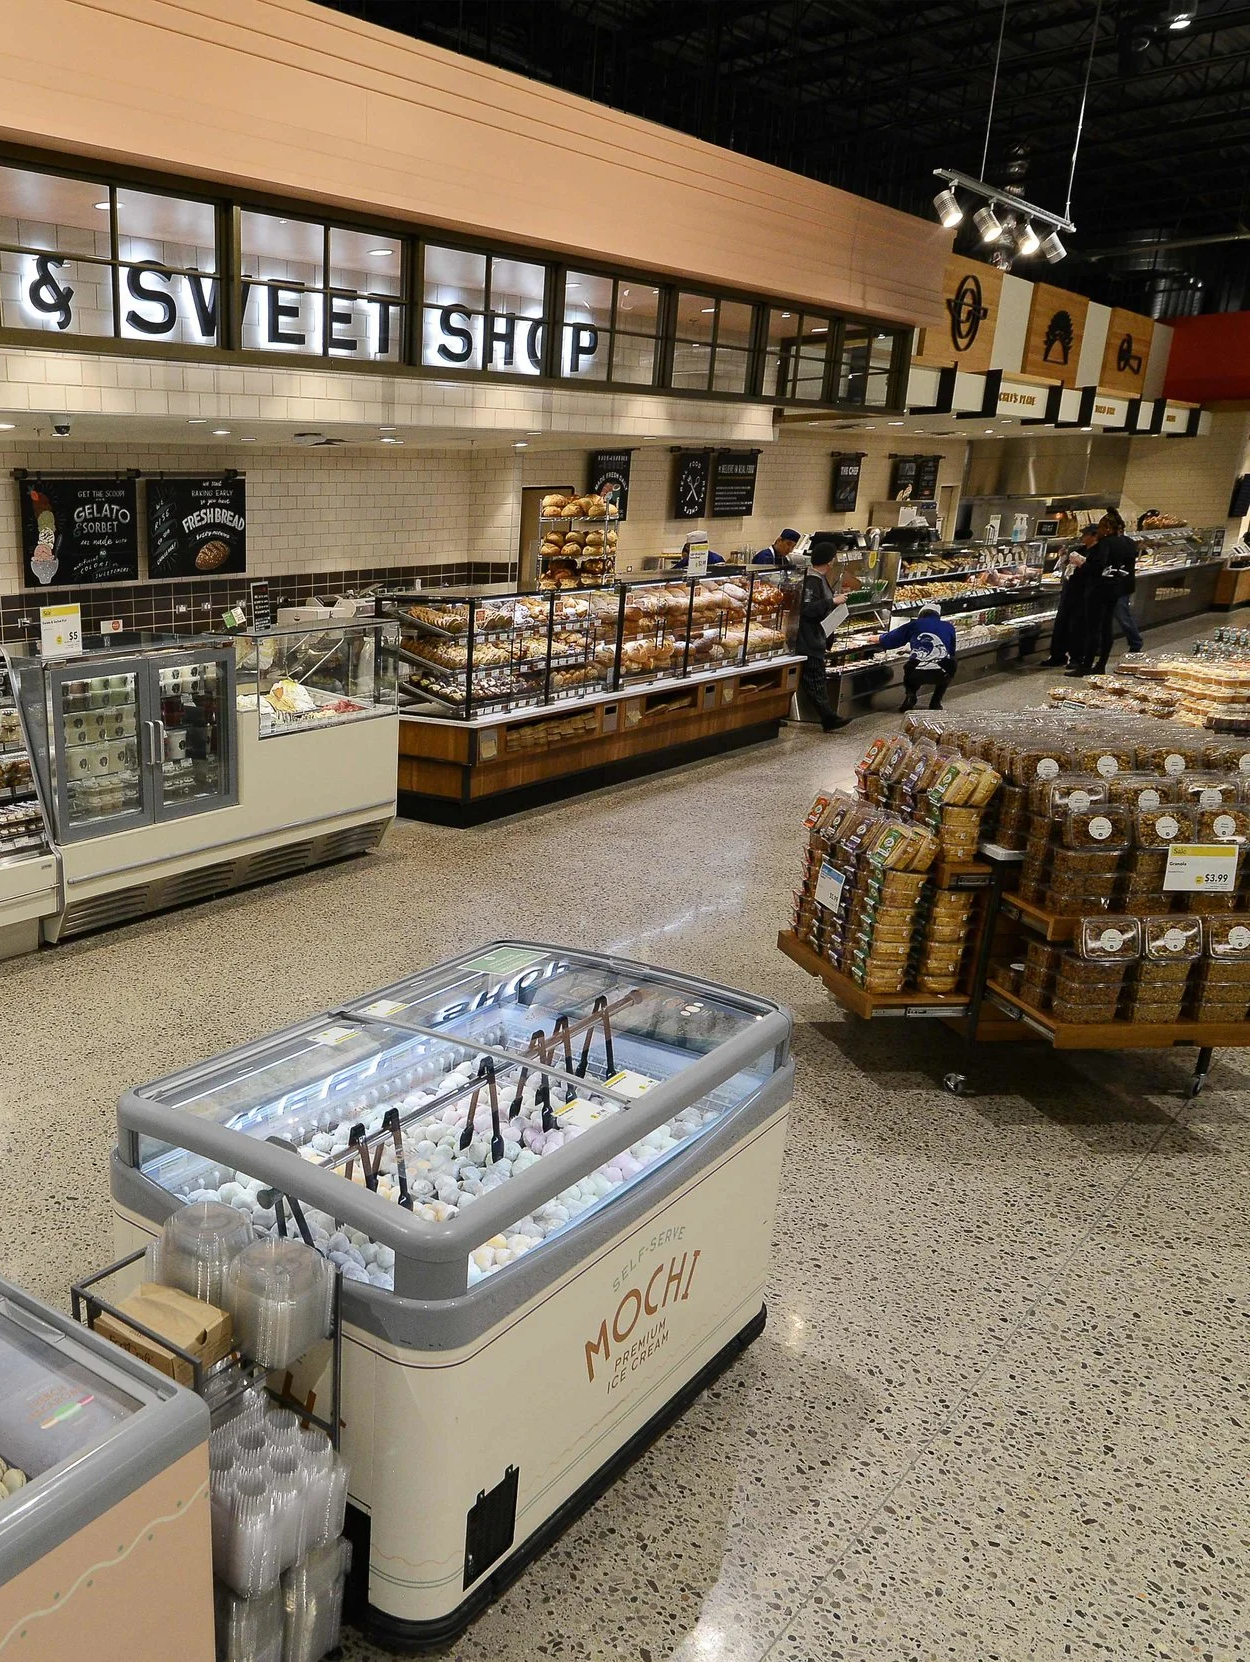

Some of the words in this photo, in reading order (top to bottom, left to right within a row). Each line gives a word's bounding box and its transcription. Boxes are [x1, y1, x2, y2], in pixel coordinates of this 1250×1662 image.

[27, 255, 75, 330] &
[123, 258, 410, 355] SWEET
[435, 302, 599, 373] SHOP
[849, 466, 859, 475] CHEF
[74, 503, 130, 523] GELATO
[182, 508, 213, 533] FRESH
[215, 508, 245, 531] BREAD
[82, 522, 118, 533] SORBET
[69, 632, 78, 640] $5
[1204, 874, 1228, 882] $3.99
[612, 1226, 686, 1293] SELF-SERVE
[584, 1250, 701, 1384] MOCHI
[614, 1318, 666, 1372] PREMIUM
[607, 1372, 626, 1394] ICE
[631, 1330, 670, 1371] CREAM
